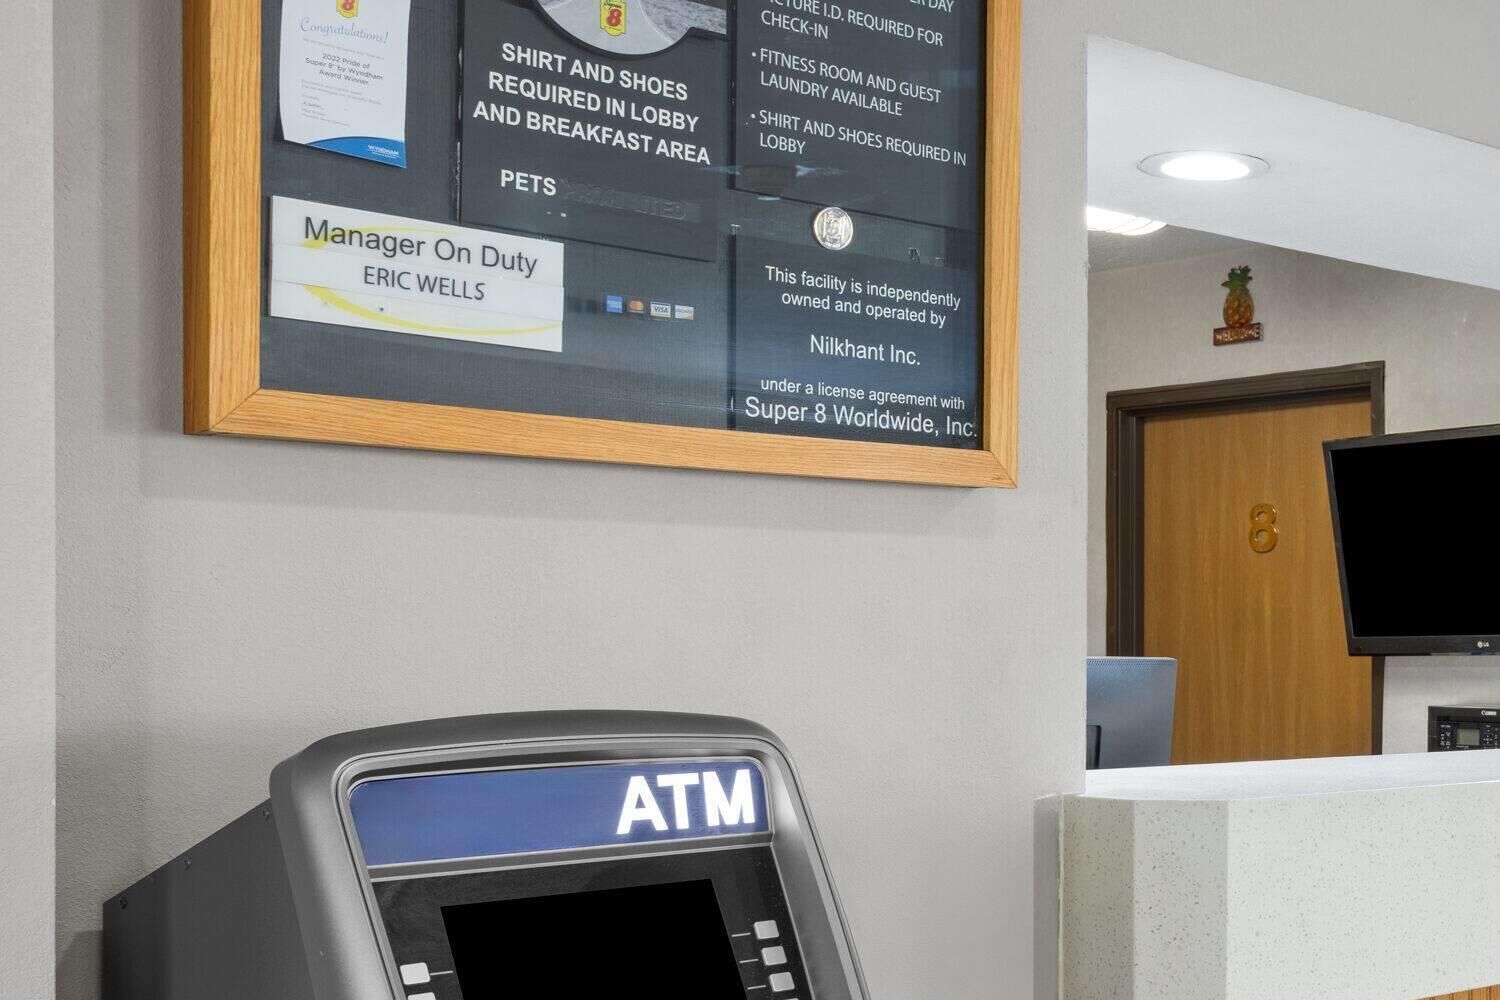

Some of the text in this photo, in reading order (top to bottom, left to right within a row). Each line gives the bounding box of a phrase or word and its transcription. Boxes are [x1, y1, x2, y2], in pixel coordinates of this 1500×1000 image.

[300, 17, 389, 44] Congratulations!
[606, 8, 622, 27] 8
[761, 10, 829, 40] CHECK-IN
[824, 3, 845, 21] I.D.
[848, 9, 914, 39] REQUIRED
[917, 27, 943, 47] FOR
[305, 57, 326, 68] Super
[337, 63, 346, 72] by
[348, 67, 384, 81] Wyndham
[319, 69, 342, 80] Award
[322, 53, 341, 63] 2022
[342, 57, 361, 68] Pride
[502, 42, 688, 101] SHIRT AND SHOES
[760, 48, 942, 103] FITNESS ROOM AND GUEST
[489, 71, 699, 133] REQUIRED IN LOBBY
[761, 71, 903, 116] LAUNDRY AVAILABLE
[473, 101, 711, 165] AND BREAKFAST AREA
[759, 109, 967, 167] SHIRT AND SHOES REQUIRED IN
[759, 132, 806, 155] LOBBY
[501, 169, 557, 196] PETS
[304, 216, 538, 279] Manager On Duty
[364, 265, 486, 301] ERIC WELLS
[765, 265, 960, 311] This facility is independently
[782, 292, 946, 328] owned and operated by
[810, 334, 921, 365] Nilkhant Inc.
[761, 378, 965, 410] under a license agreement with
[745, 396, 977, 438] Super 8 Worldwide, Inc.
[1249, 502, 1279, 553] 8
[616, 769, 757, 835] ATM
